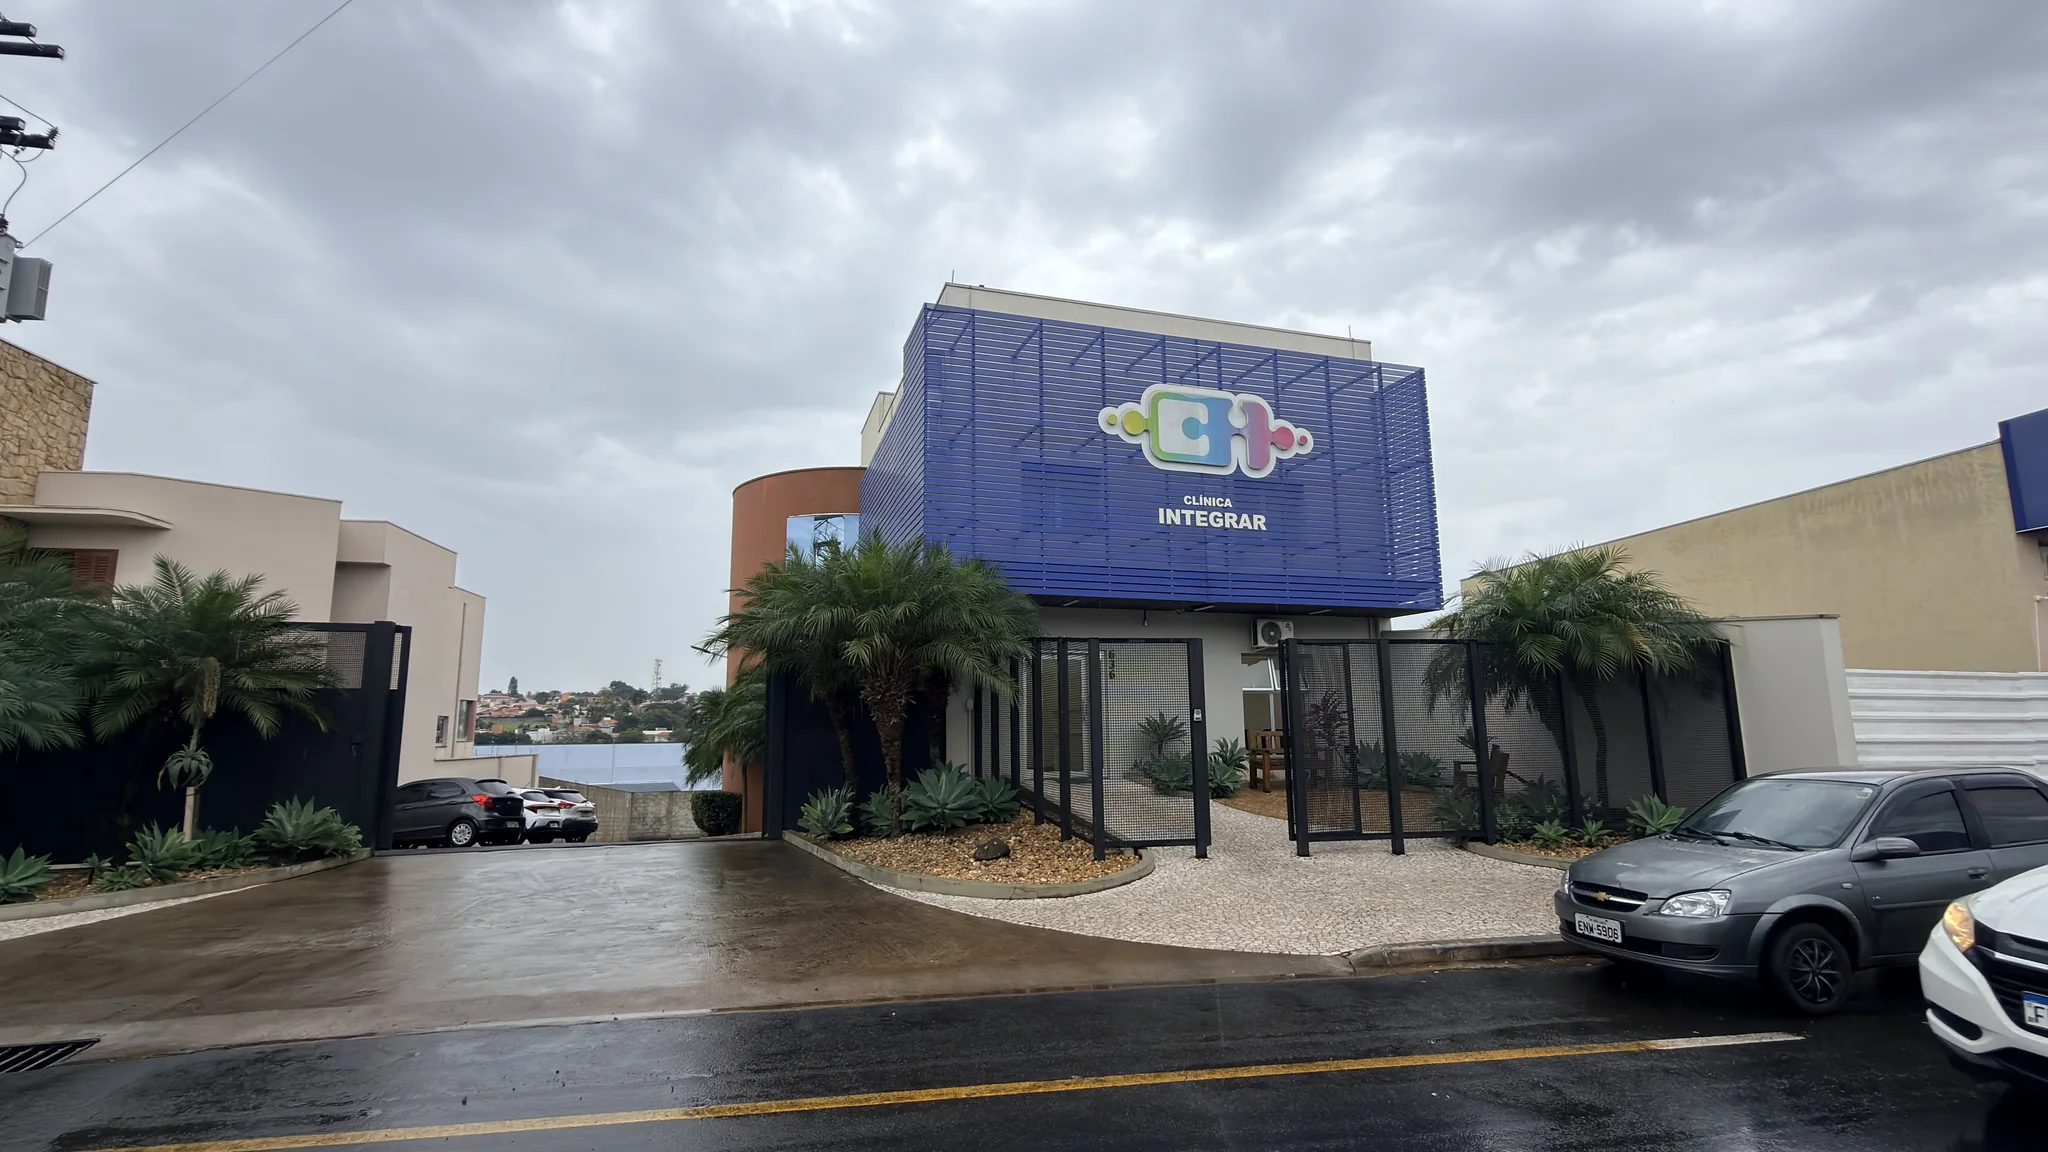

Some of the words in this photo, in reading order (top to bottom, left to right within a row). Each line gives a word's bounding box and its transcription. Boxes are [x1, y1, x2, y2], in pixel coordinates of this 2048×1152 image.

[1183, 494, 1233, 508] CLÍNICA
[1158, 507, 1267, 531] INTEGRAR
[1108, 650, 1116, 680] 636
